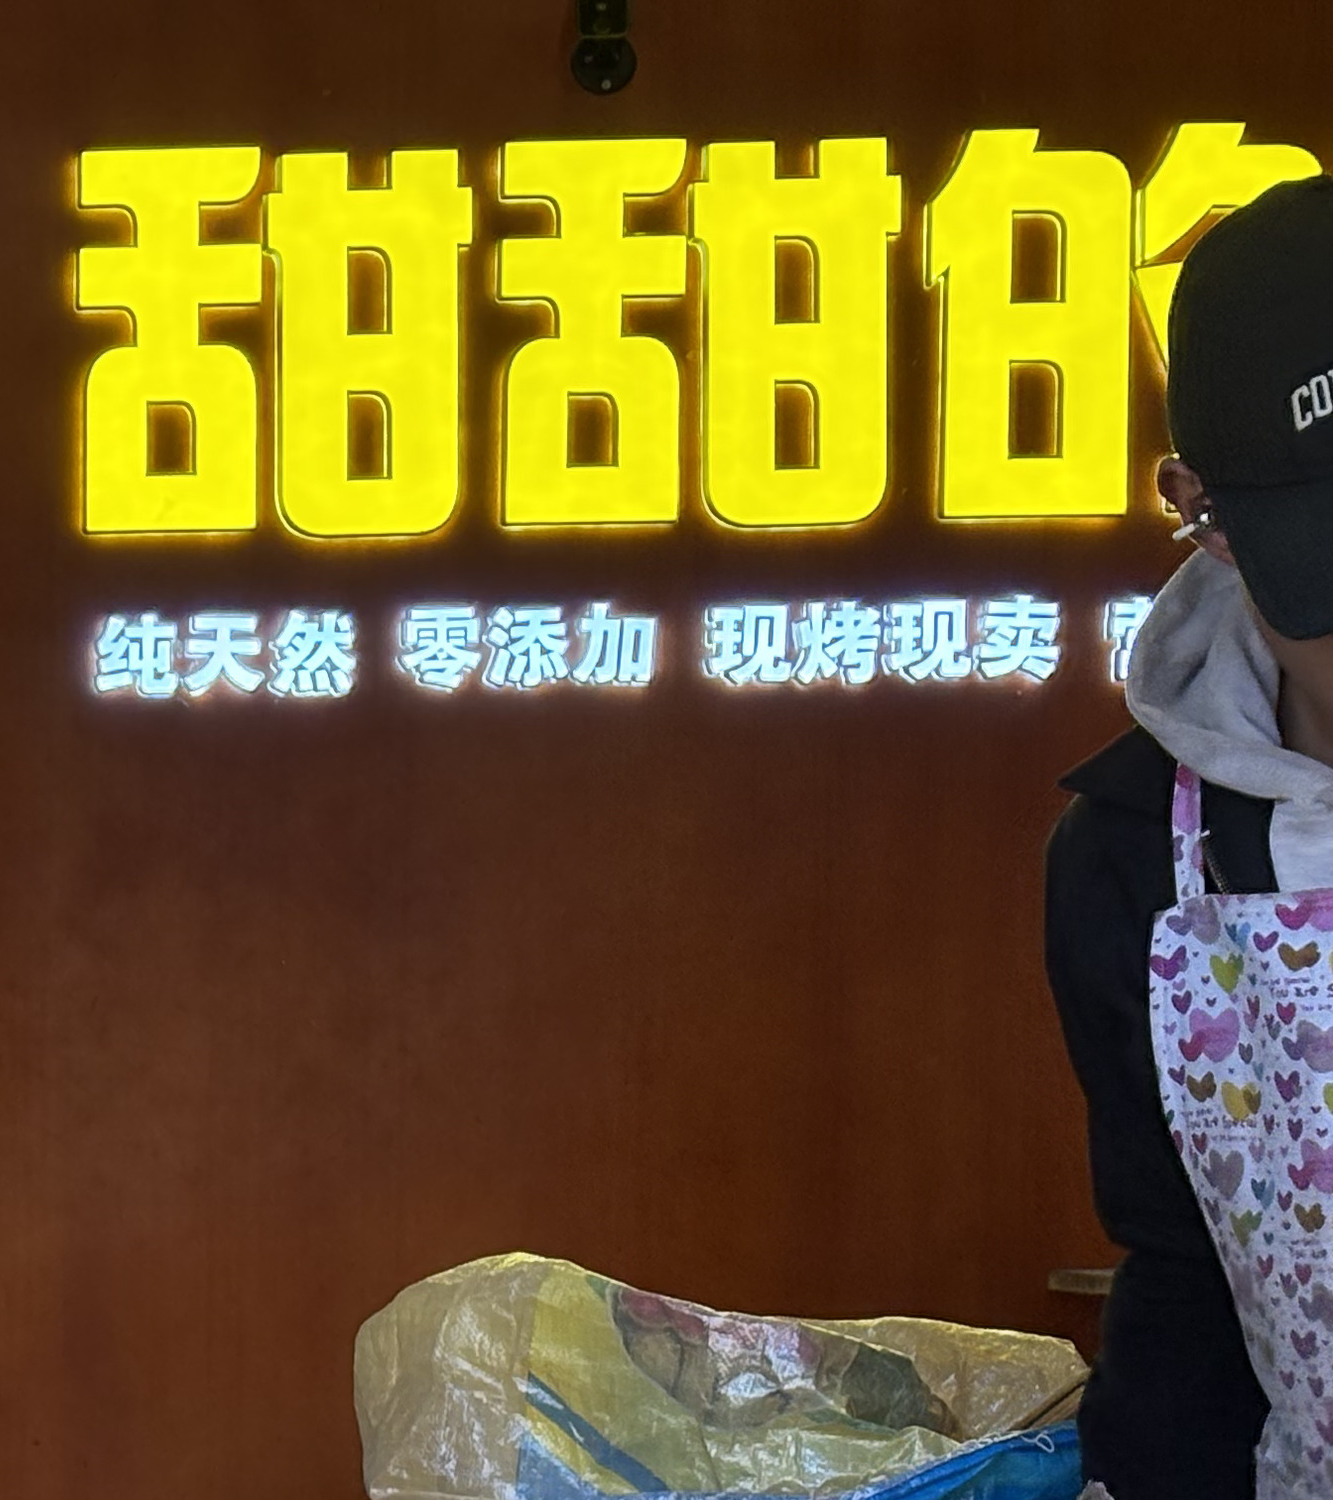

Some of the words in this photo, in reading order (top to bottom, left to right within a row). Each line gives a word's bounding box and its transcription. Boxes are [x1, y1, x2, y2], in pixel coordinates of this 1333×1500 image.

[92, 609, 358, 699] 纯天然
[393, 601, 658, 694] 零添加
[701, 594, 1061, 688] 现烤现卖
